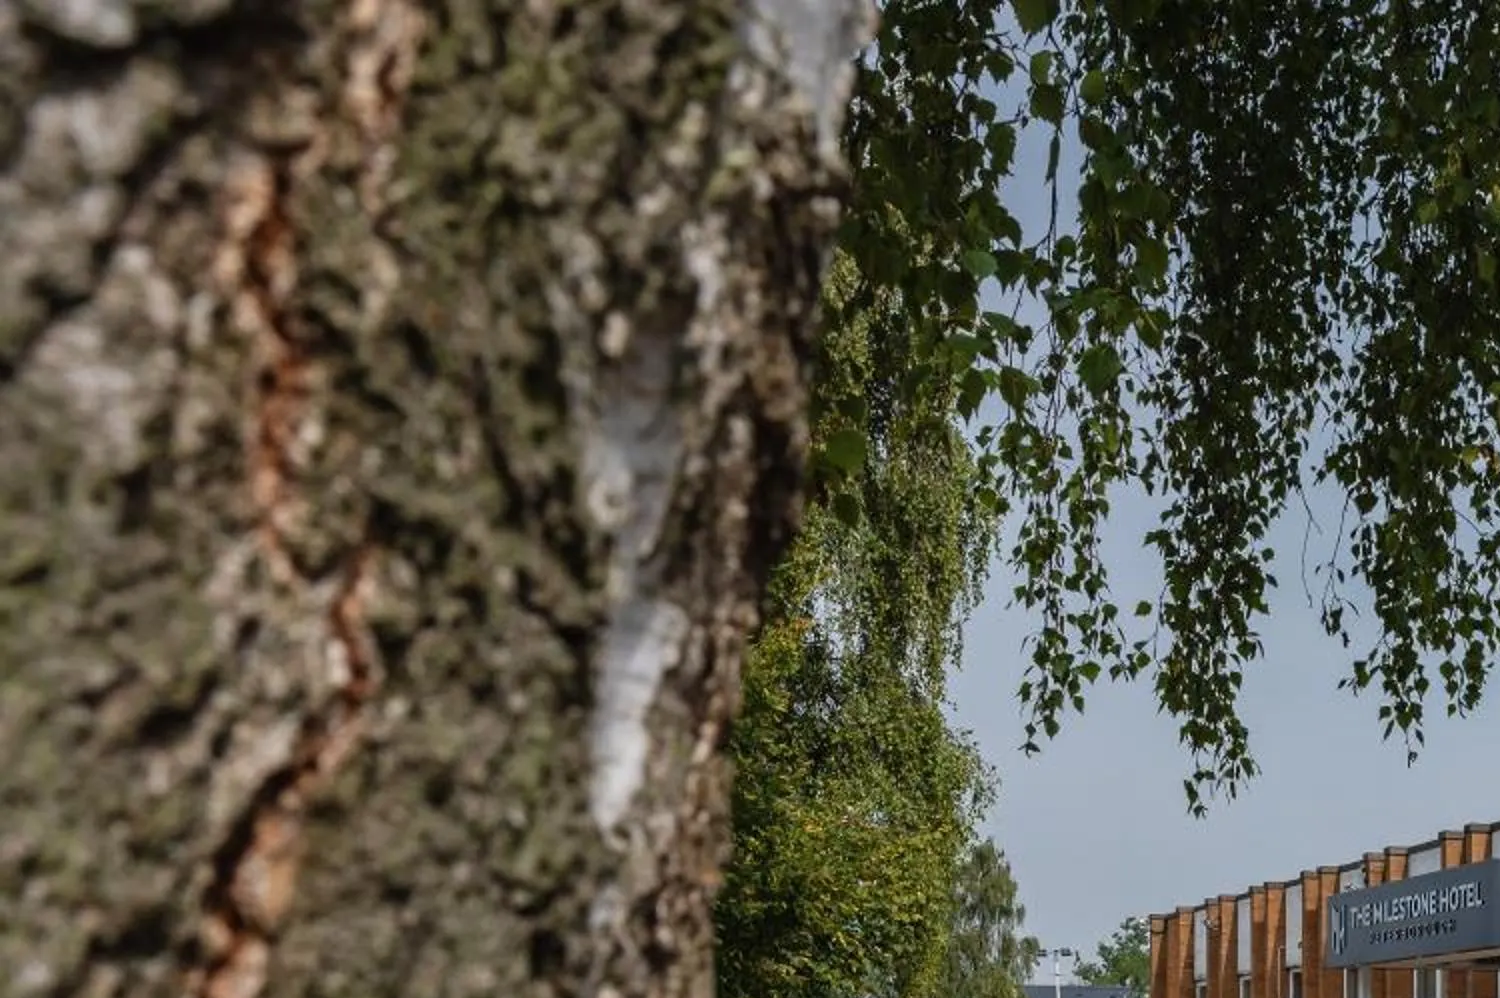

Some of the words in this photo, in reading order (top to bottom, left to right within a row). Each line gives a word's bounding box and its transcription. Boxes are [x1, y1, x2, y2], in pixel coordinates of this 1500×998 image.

[1351, 903, 1371, 928] THE
[1373, 891, 1436, 925] MILESTONE
[1439, 880, 1484, 913] HOTEL
